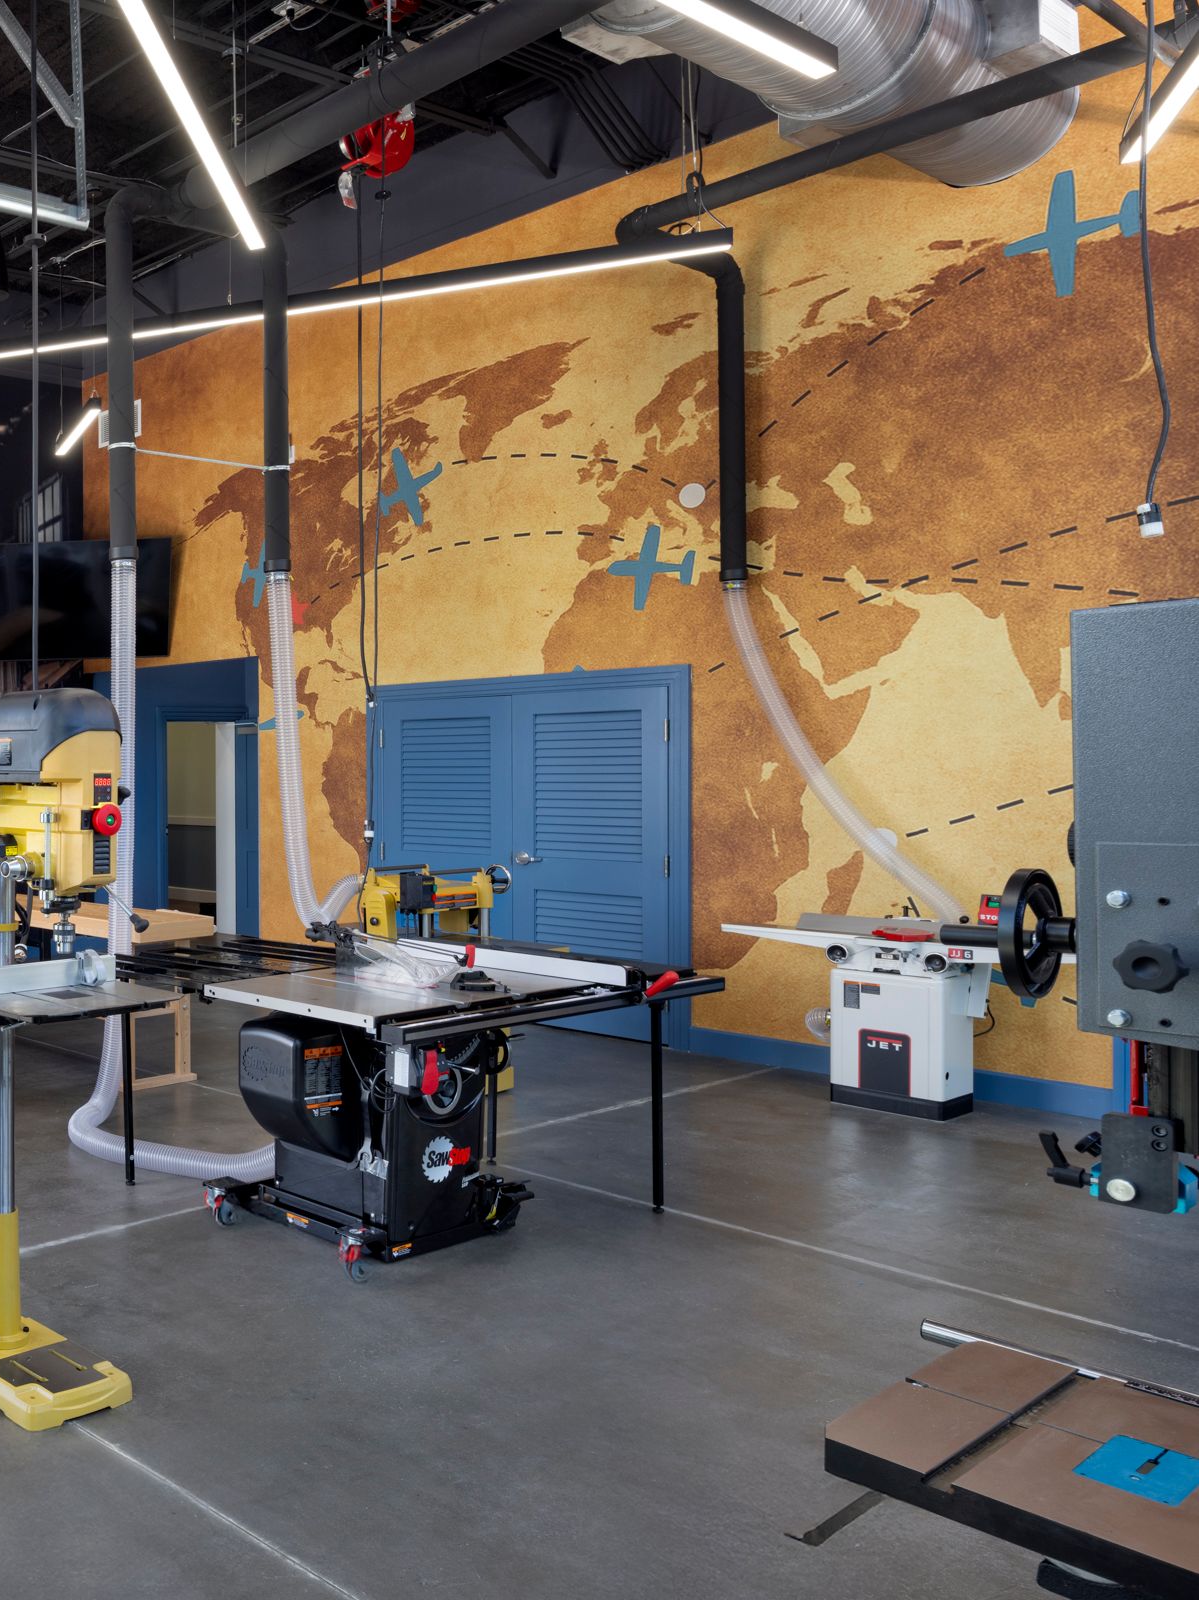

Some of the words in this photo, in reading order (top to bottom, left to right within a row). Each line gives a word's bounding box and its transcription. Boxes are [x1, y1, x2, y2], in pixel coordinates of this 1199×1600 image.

[949, 949, 961, 958] JJ
[964, 950, 972, 959] 6
[866, 1040, 903, 1051] JET
